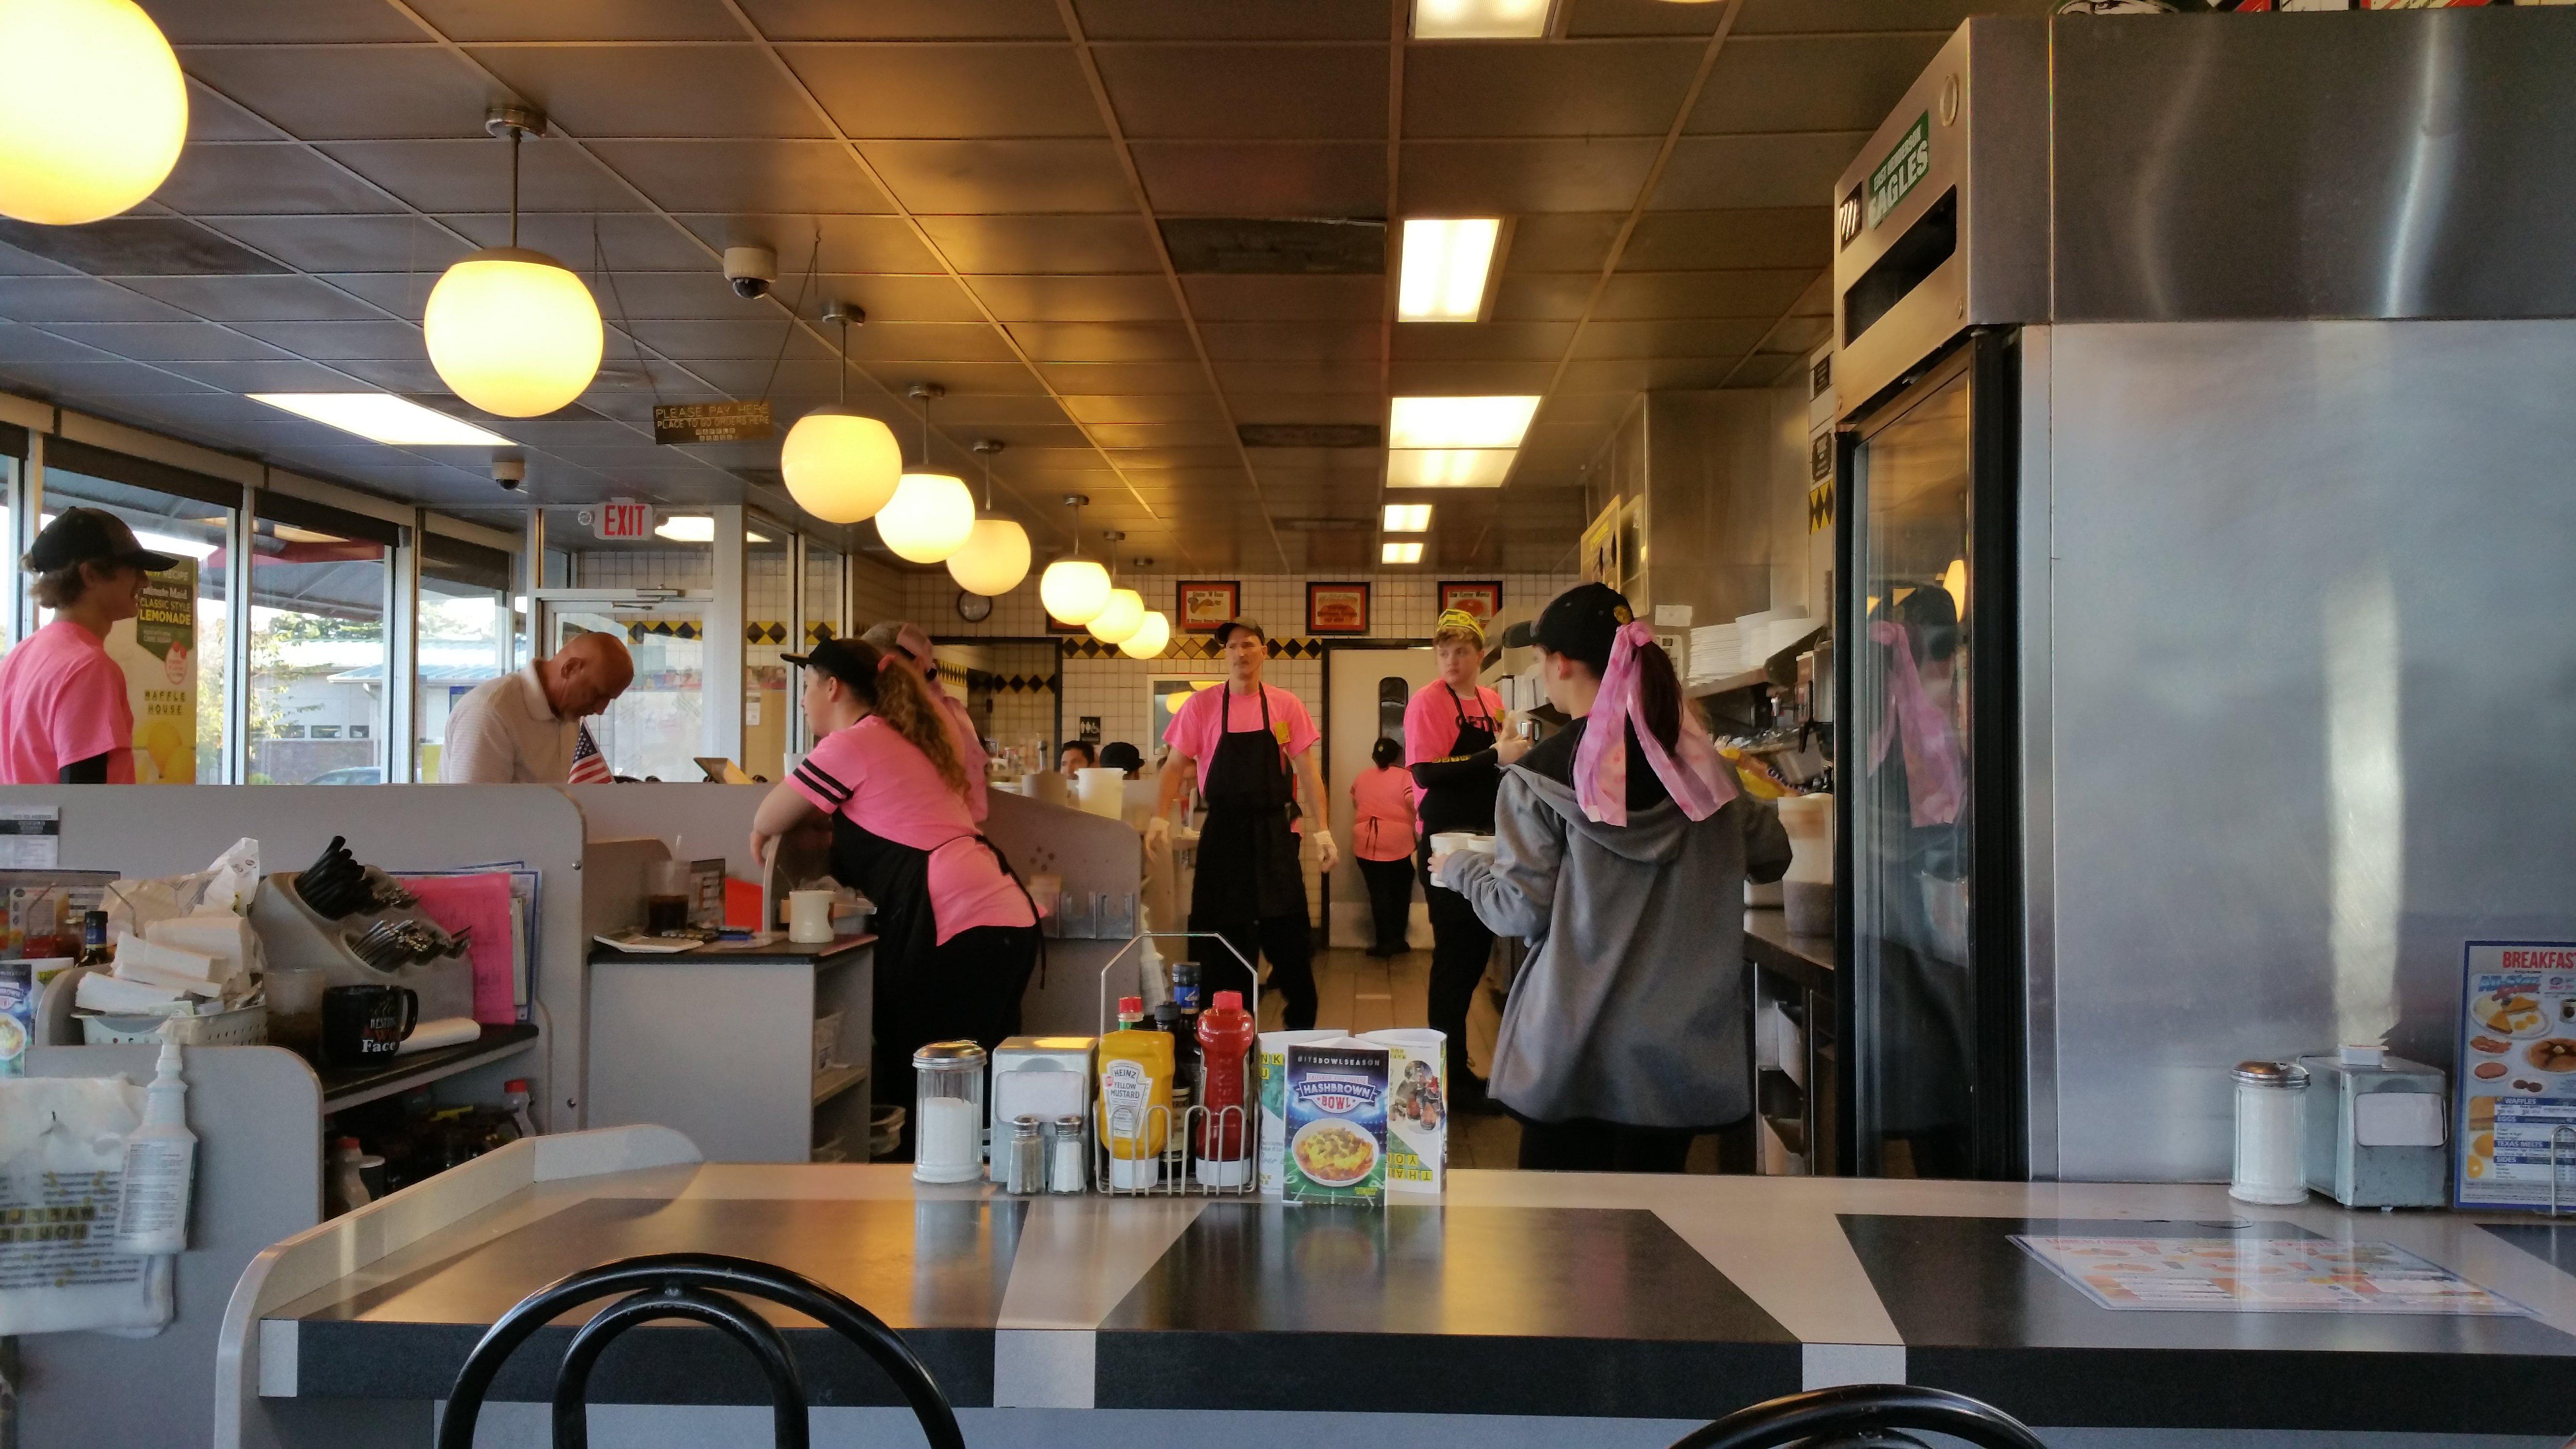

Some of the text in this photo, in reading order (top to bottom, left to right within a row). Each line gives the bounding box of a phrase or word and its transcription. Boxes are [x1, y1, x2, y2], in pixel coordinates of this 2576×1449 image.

[1868, 140, 1929, 228] EAGLES
[656, 404, 768, 419] PLEASE PAY HERE
[658, 419, 684, 429] PLACE
[700, 419, 712, 427] GO
[715, 417, 746, 426] ORDERS
[750, 416, 769, 424] HERE
[604, 505, 645, 536] EXIT
[163, 570, 189, 581] RECIPE
[140, 597, 191, 612] CLASSIC STYLE
[140, 609, 191, 625] LEMONADE
[145, 691, 186, 701] WAFFLE
[148, 704, 182, 714] HOUSE
[362, 1039, 396, 1052] Face
[1114, 1068, 1137, 1079] HEINZ
[1115, 1081, 1136, 1090] YELLOW
[1303, 1082, 1370, 1097] HASHBROWN
[1111, 1090, 1140, 1098] MUSTARD
[1322, 1096, 1351, 1110] BOWL
[1388, 1170, 1430, 1180] THA
